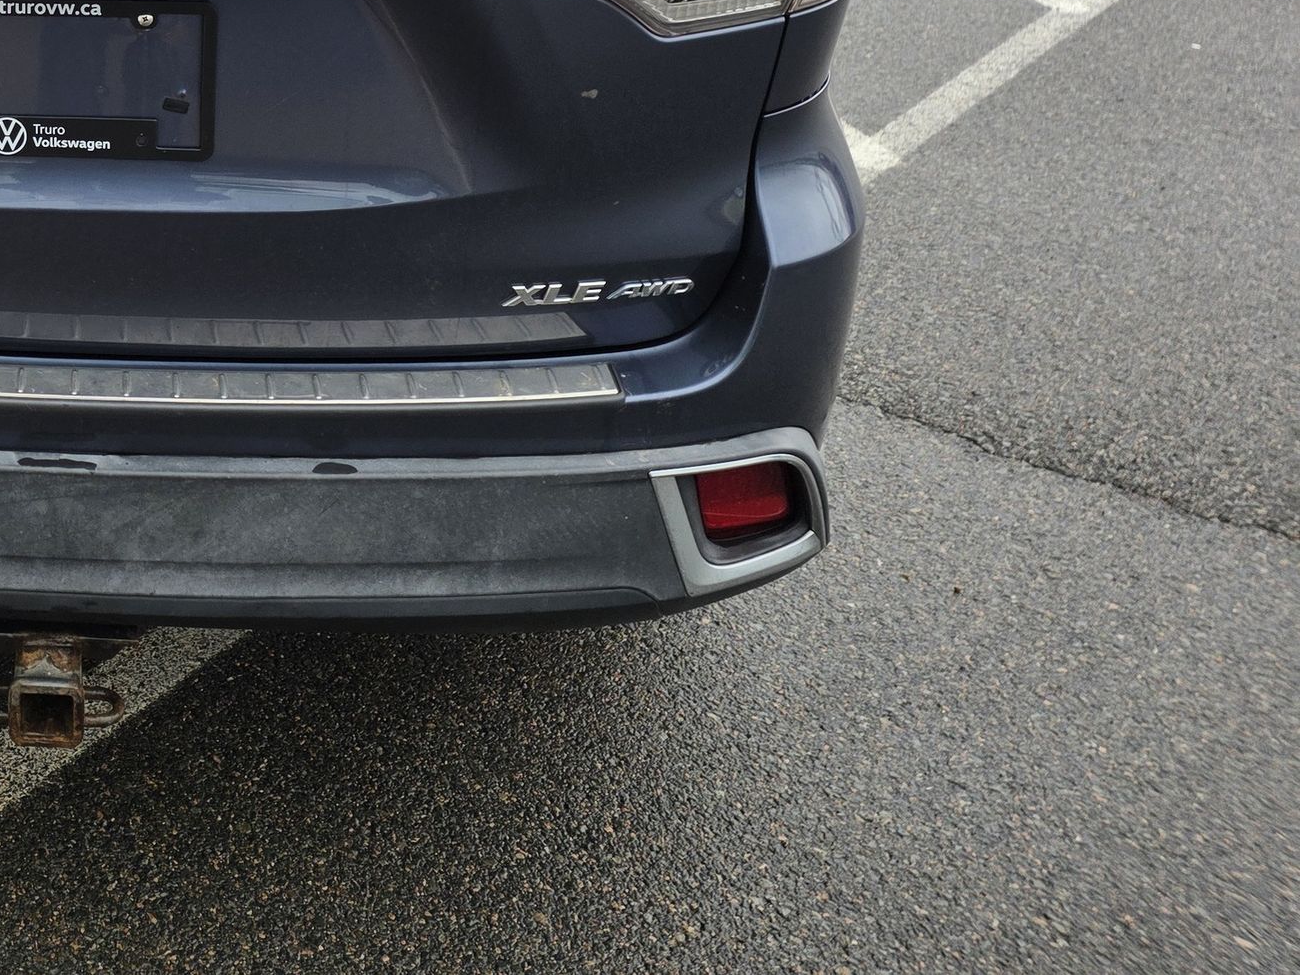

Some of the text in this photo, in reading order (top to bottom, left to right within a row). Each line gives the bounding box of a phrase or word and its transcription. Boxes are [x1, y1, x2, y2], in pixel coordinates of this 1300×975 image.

[32, 123, 66, 136] Truro
[32, 136, 111, 152] Volkswagen
[501, 275, 696, 307] XLE AWD
